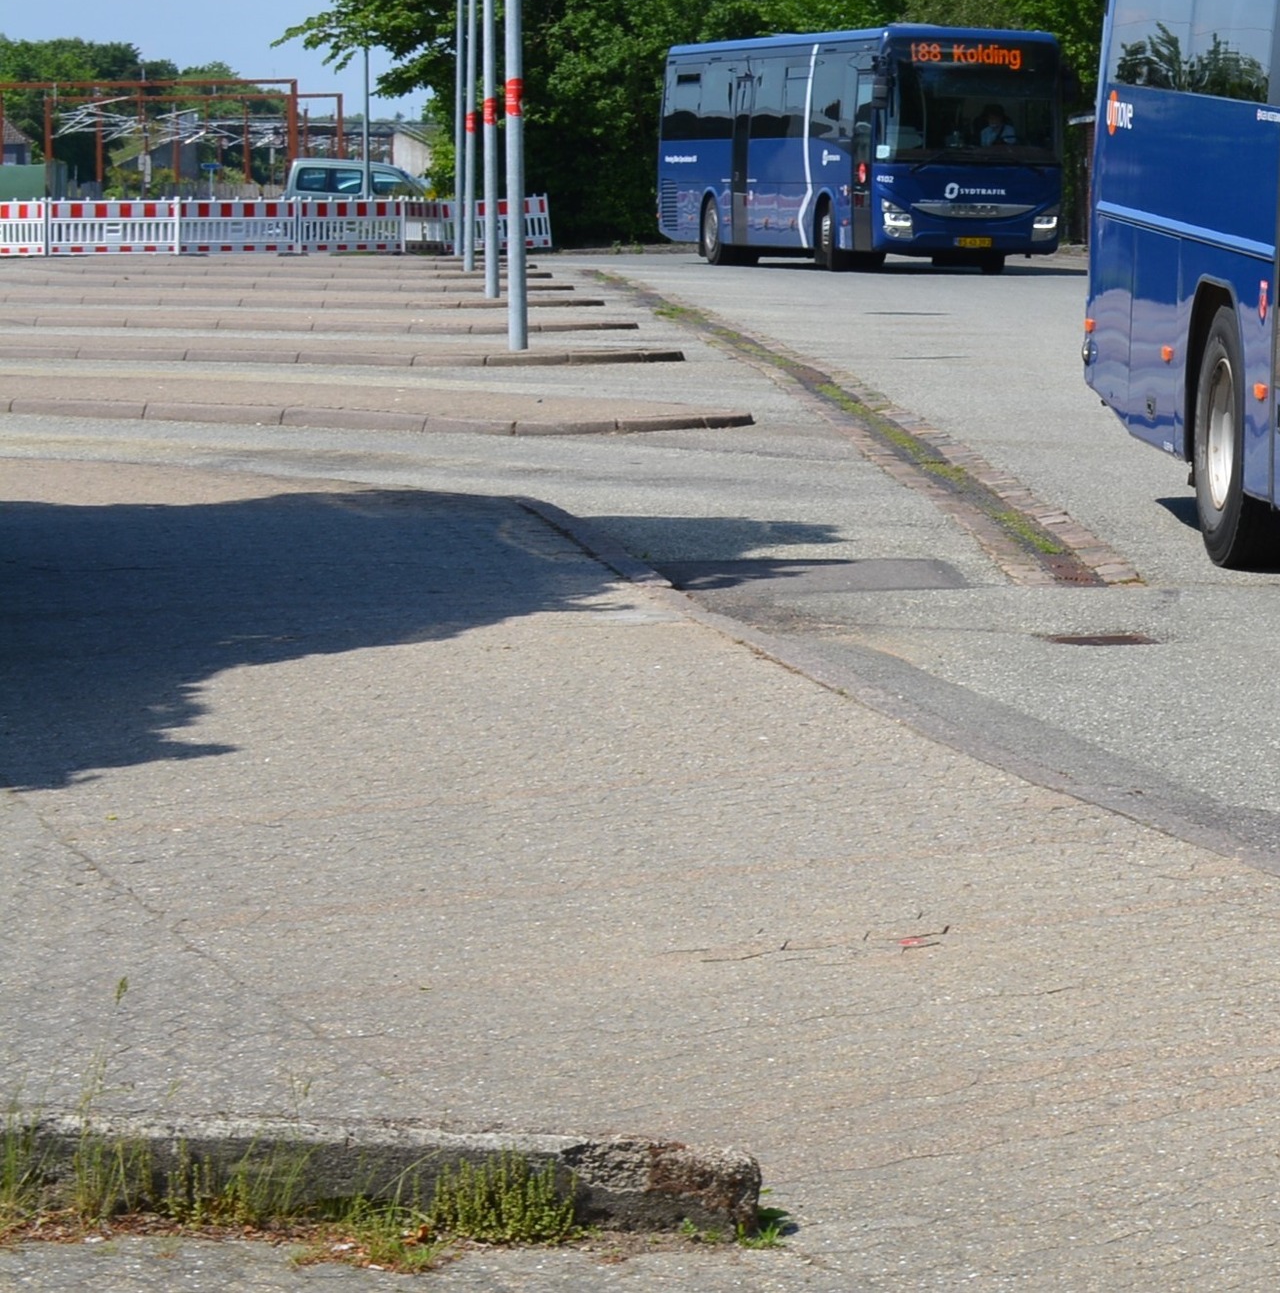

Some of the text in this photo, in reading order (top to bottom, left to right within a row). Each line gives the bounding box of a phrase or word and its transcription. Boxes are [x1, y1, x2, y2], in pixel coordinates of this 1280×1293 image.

[952, 43, 1021, 70] Kolding
[876, 174, 895, 184] 4102
[960, 188, 1006, 196] SYDTRAFIK
